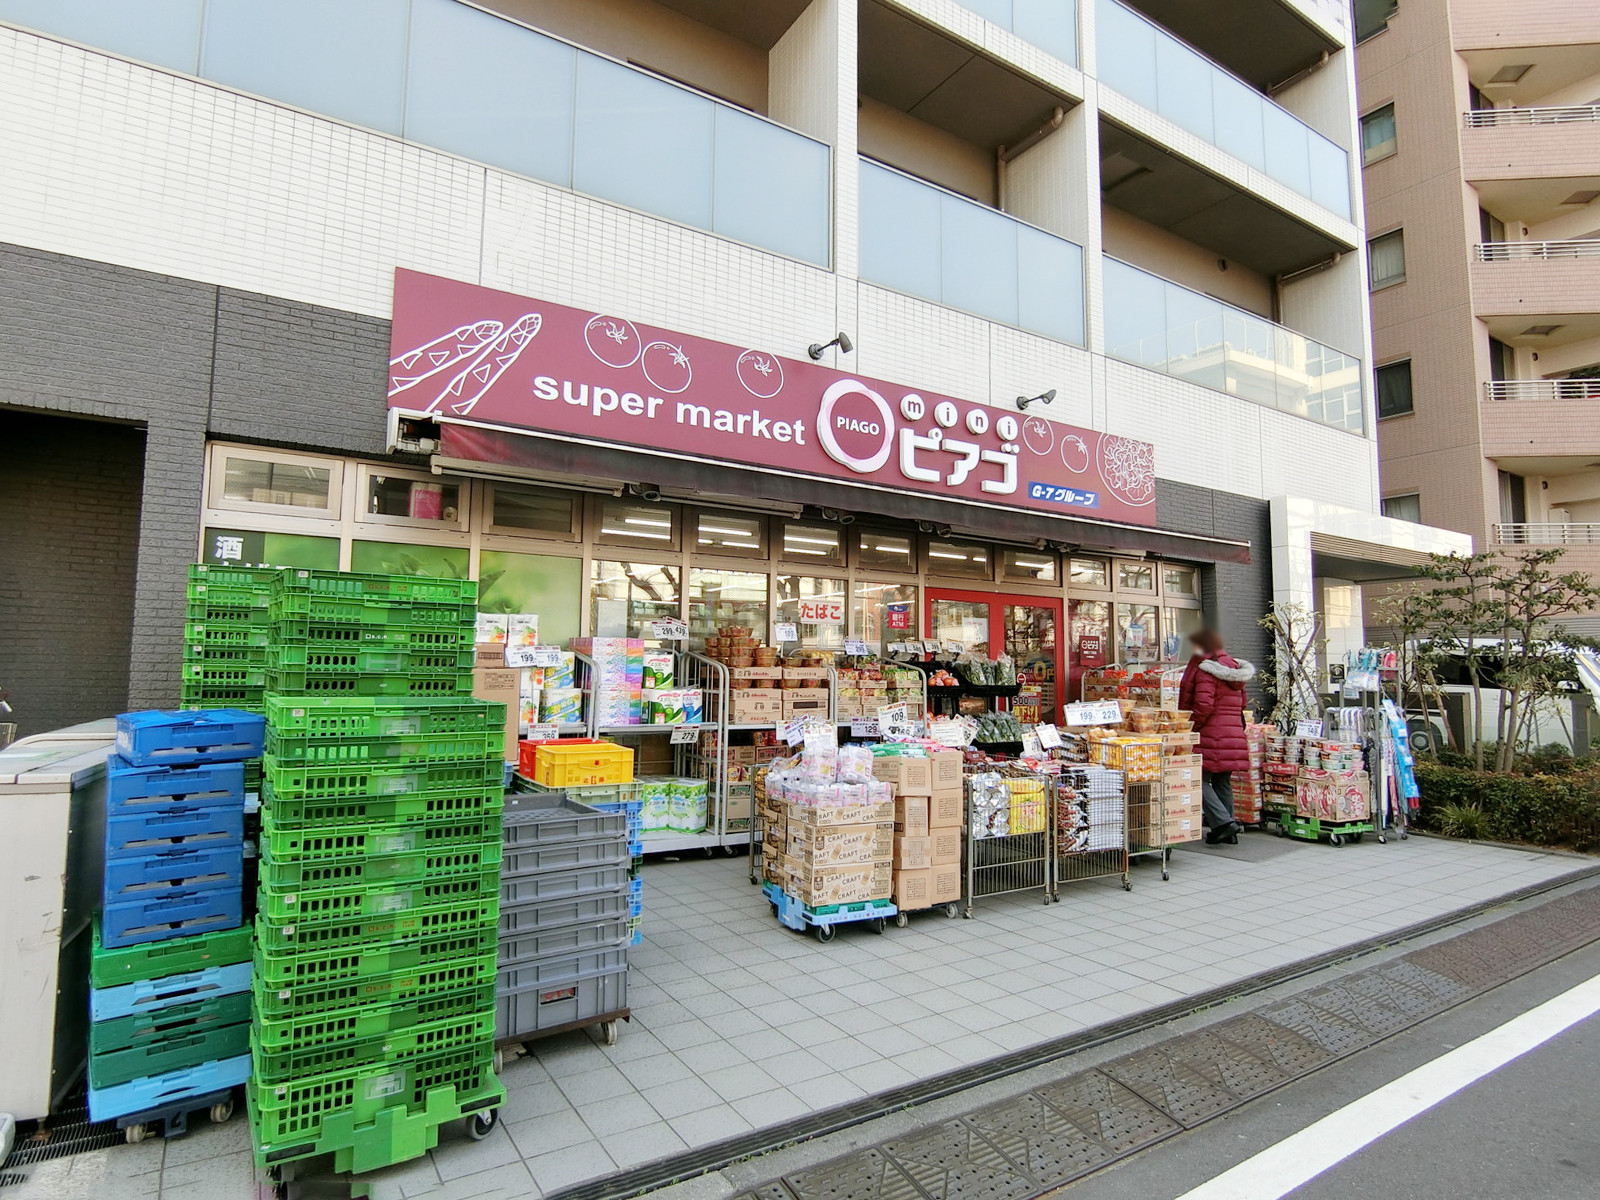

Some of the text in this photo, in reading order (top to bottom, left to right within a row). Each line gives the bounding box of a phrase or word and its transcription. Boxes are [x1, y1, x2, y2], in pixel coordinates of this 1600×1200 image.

[533, 375, 806, 446] super market
[904, 397, 1015, 438] mini
[836, 416, 880, 436] PIAGO
[900, 428, 1019, 494] ピアゴ
[215, 535, 244, 561] 酒
[801, 602, 841, 620] たばこ
[891, 613, 905, 621] 銀行
[520, 653, 534, 662] 199
[891, 711, 904, 723] 109
[1080, 709, 1117, 720] 199 229
[864, 725, 878, 733] 129
[681, 732, 695, 740] 279
[817, 811, 834, 821] RAFT
[842, 810, 861, 821] CRAFT
[827, 833, 847, 843] CRAFT
[843, 835, 863, 845] CRAFT
[813, 851, 830, 860] RAFT
[838, 850, 858, 860] CRAFT
[826, 872, 846, 883] CRAFT
[842, 874, 861, 885] CRAFT
[811, 891, 829, 901] RAFT
[837, 889, 857, 900] CRAFT
